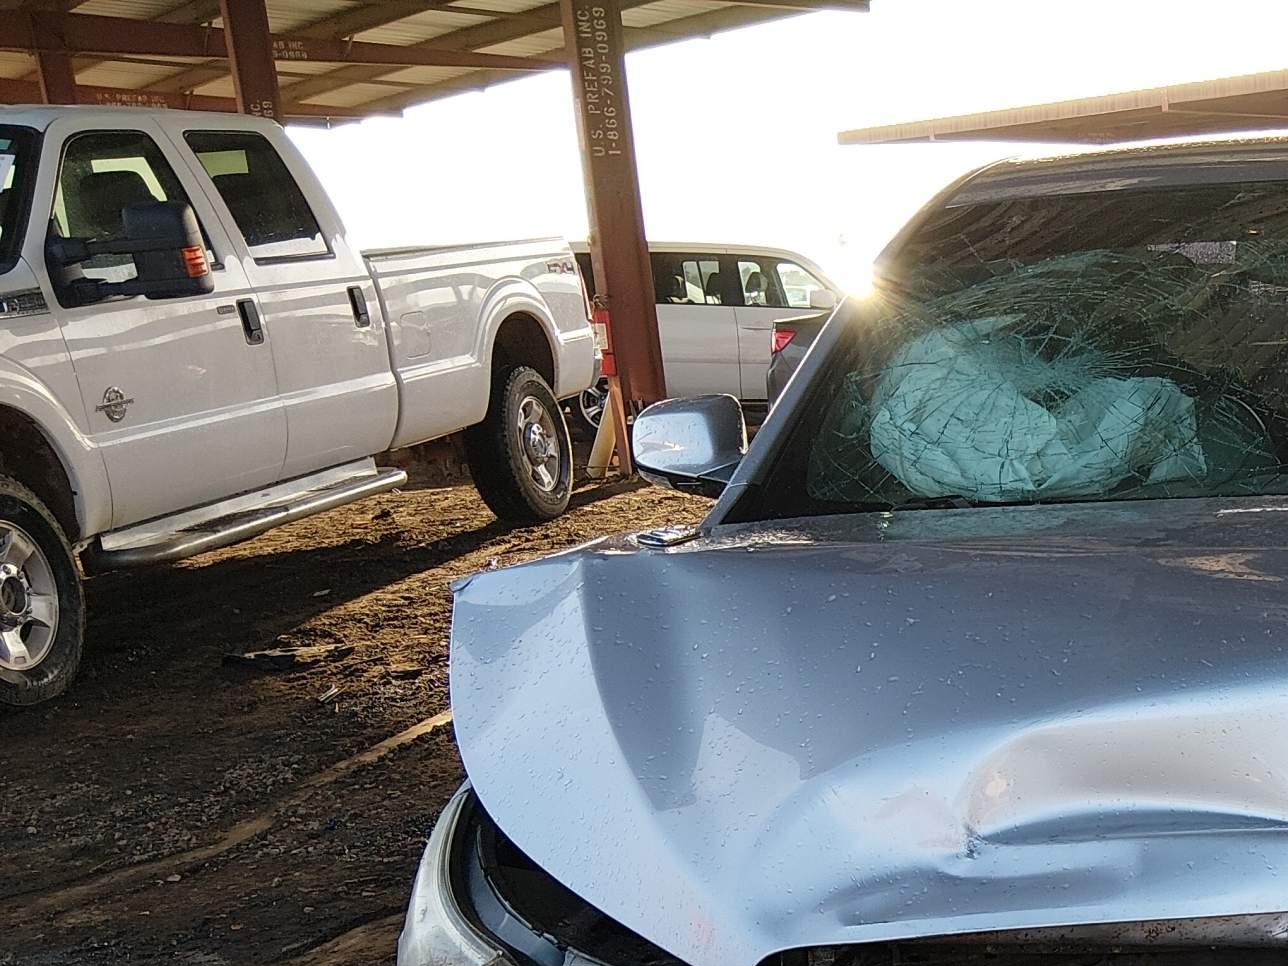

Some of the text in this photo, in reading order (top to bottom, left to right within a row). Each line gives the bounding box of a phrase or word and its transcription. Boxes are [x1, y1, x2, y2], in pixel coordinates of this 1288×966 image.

[576, 4, 592, 38] INC.
[582, 47, 601, 114] PREFAB
[592, 6, 622, 156] 1-866-799-0969
